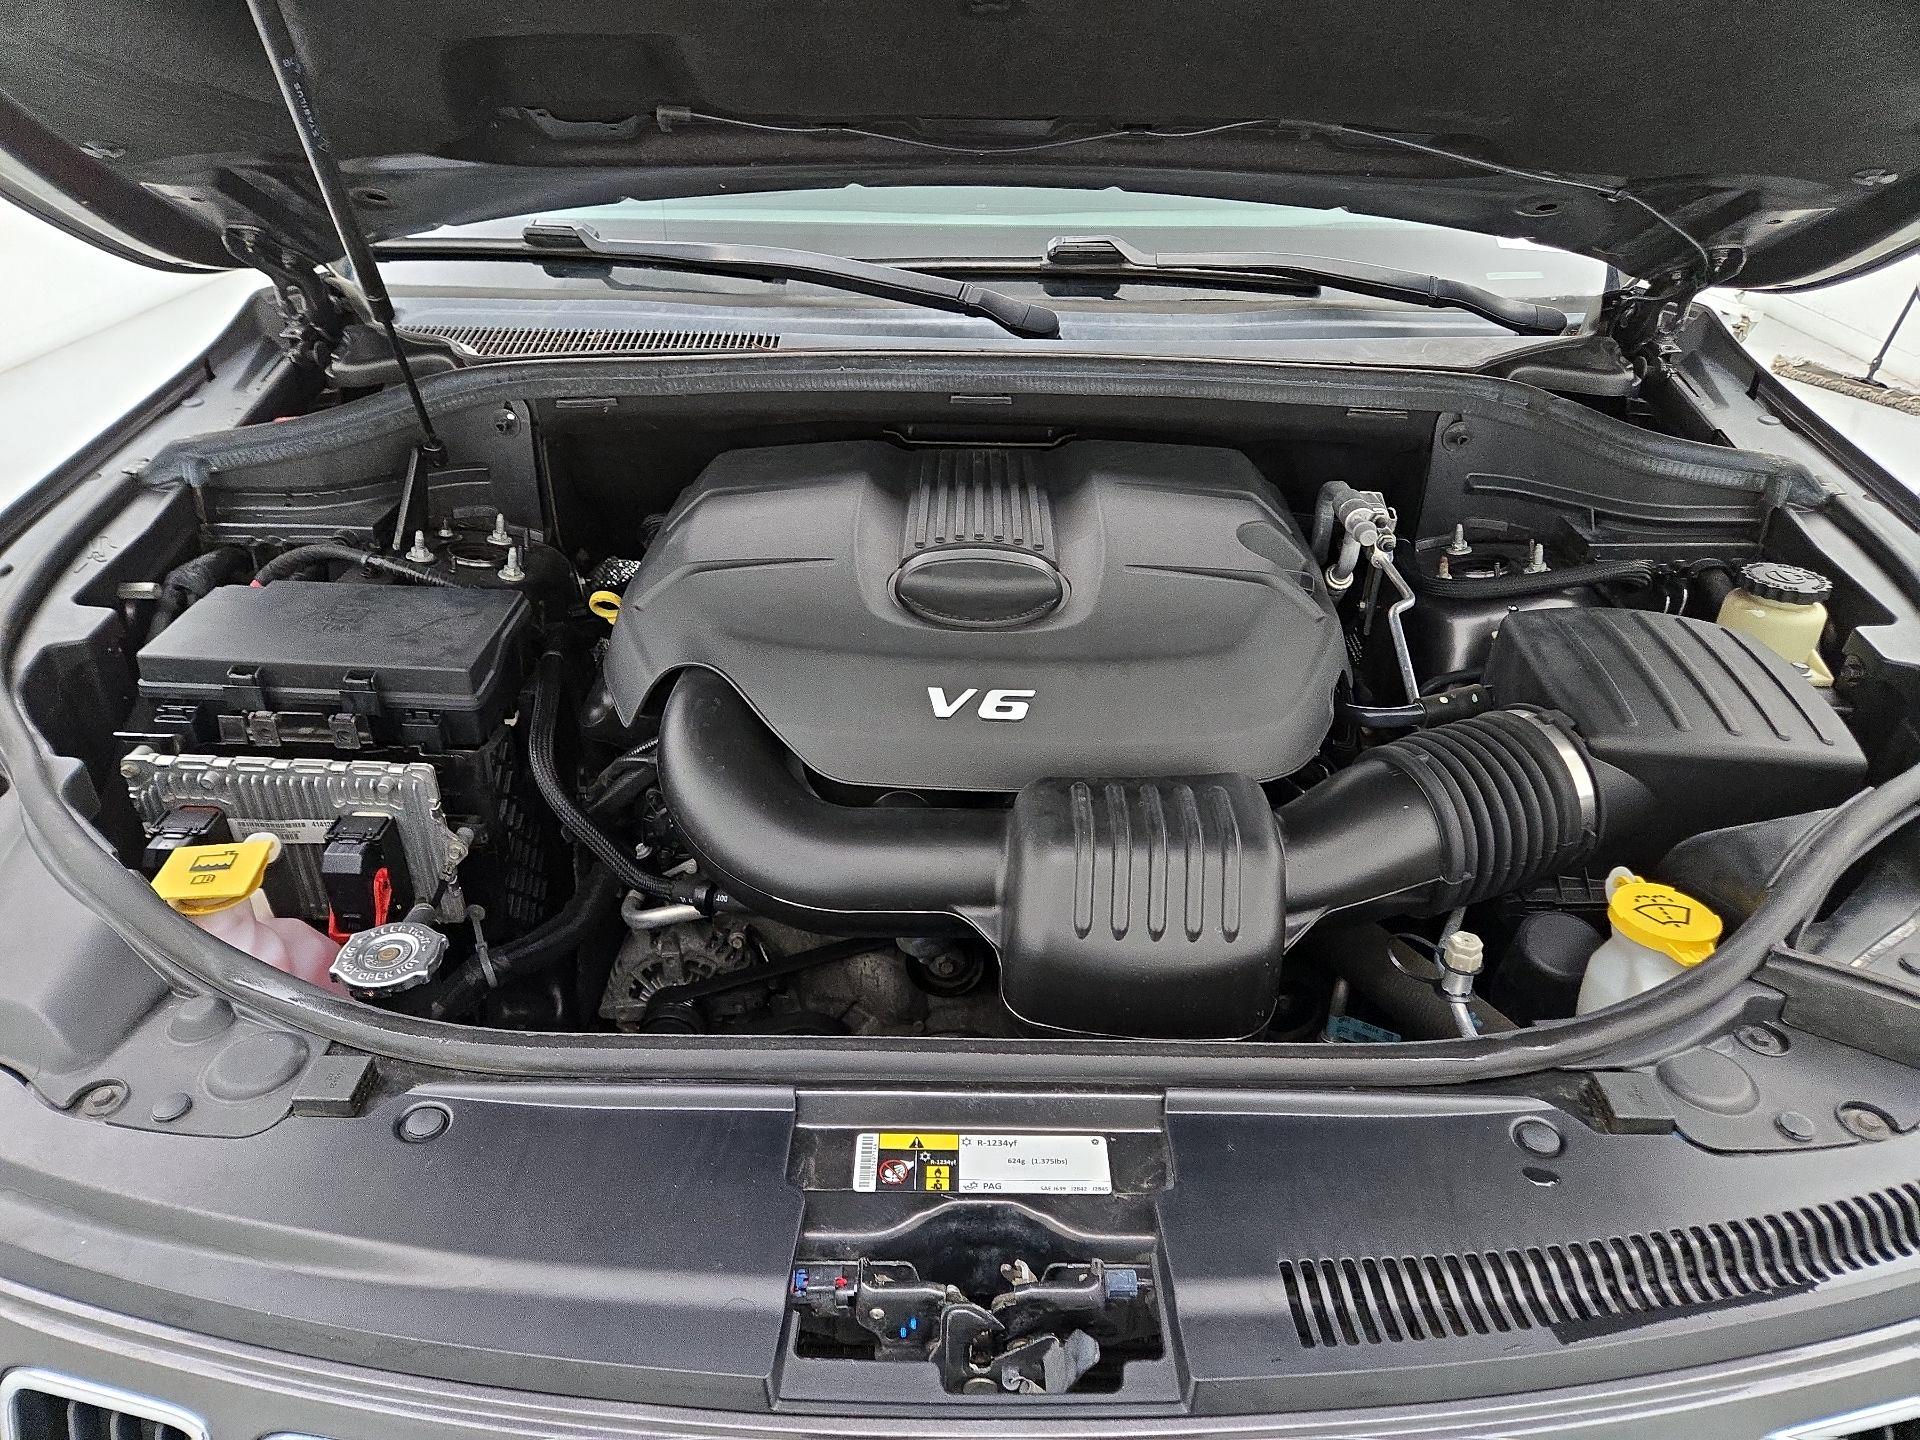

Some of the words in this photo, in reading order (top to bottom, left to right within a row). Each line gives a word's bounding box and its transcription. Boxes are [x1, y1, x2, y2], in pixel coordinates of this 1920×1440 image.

[927, 686, 1037, 720] V6
[977, 1139, 1018, 1148] R-1234yf
[983, 1182, 1002, 1190] PAG
